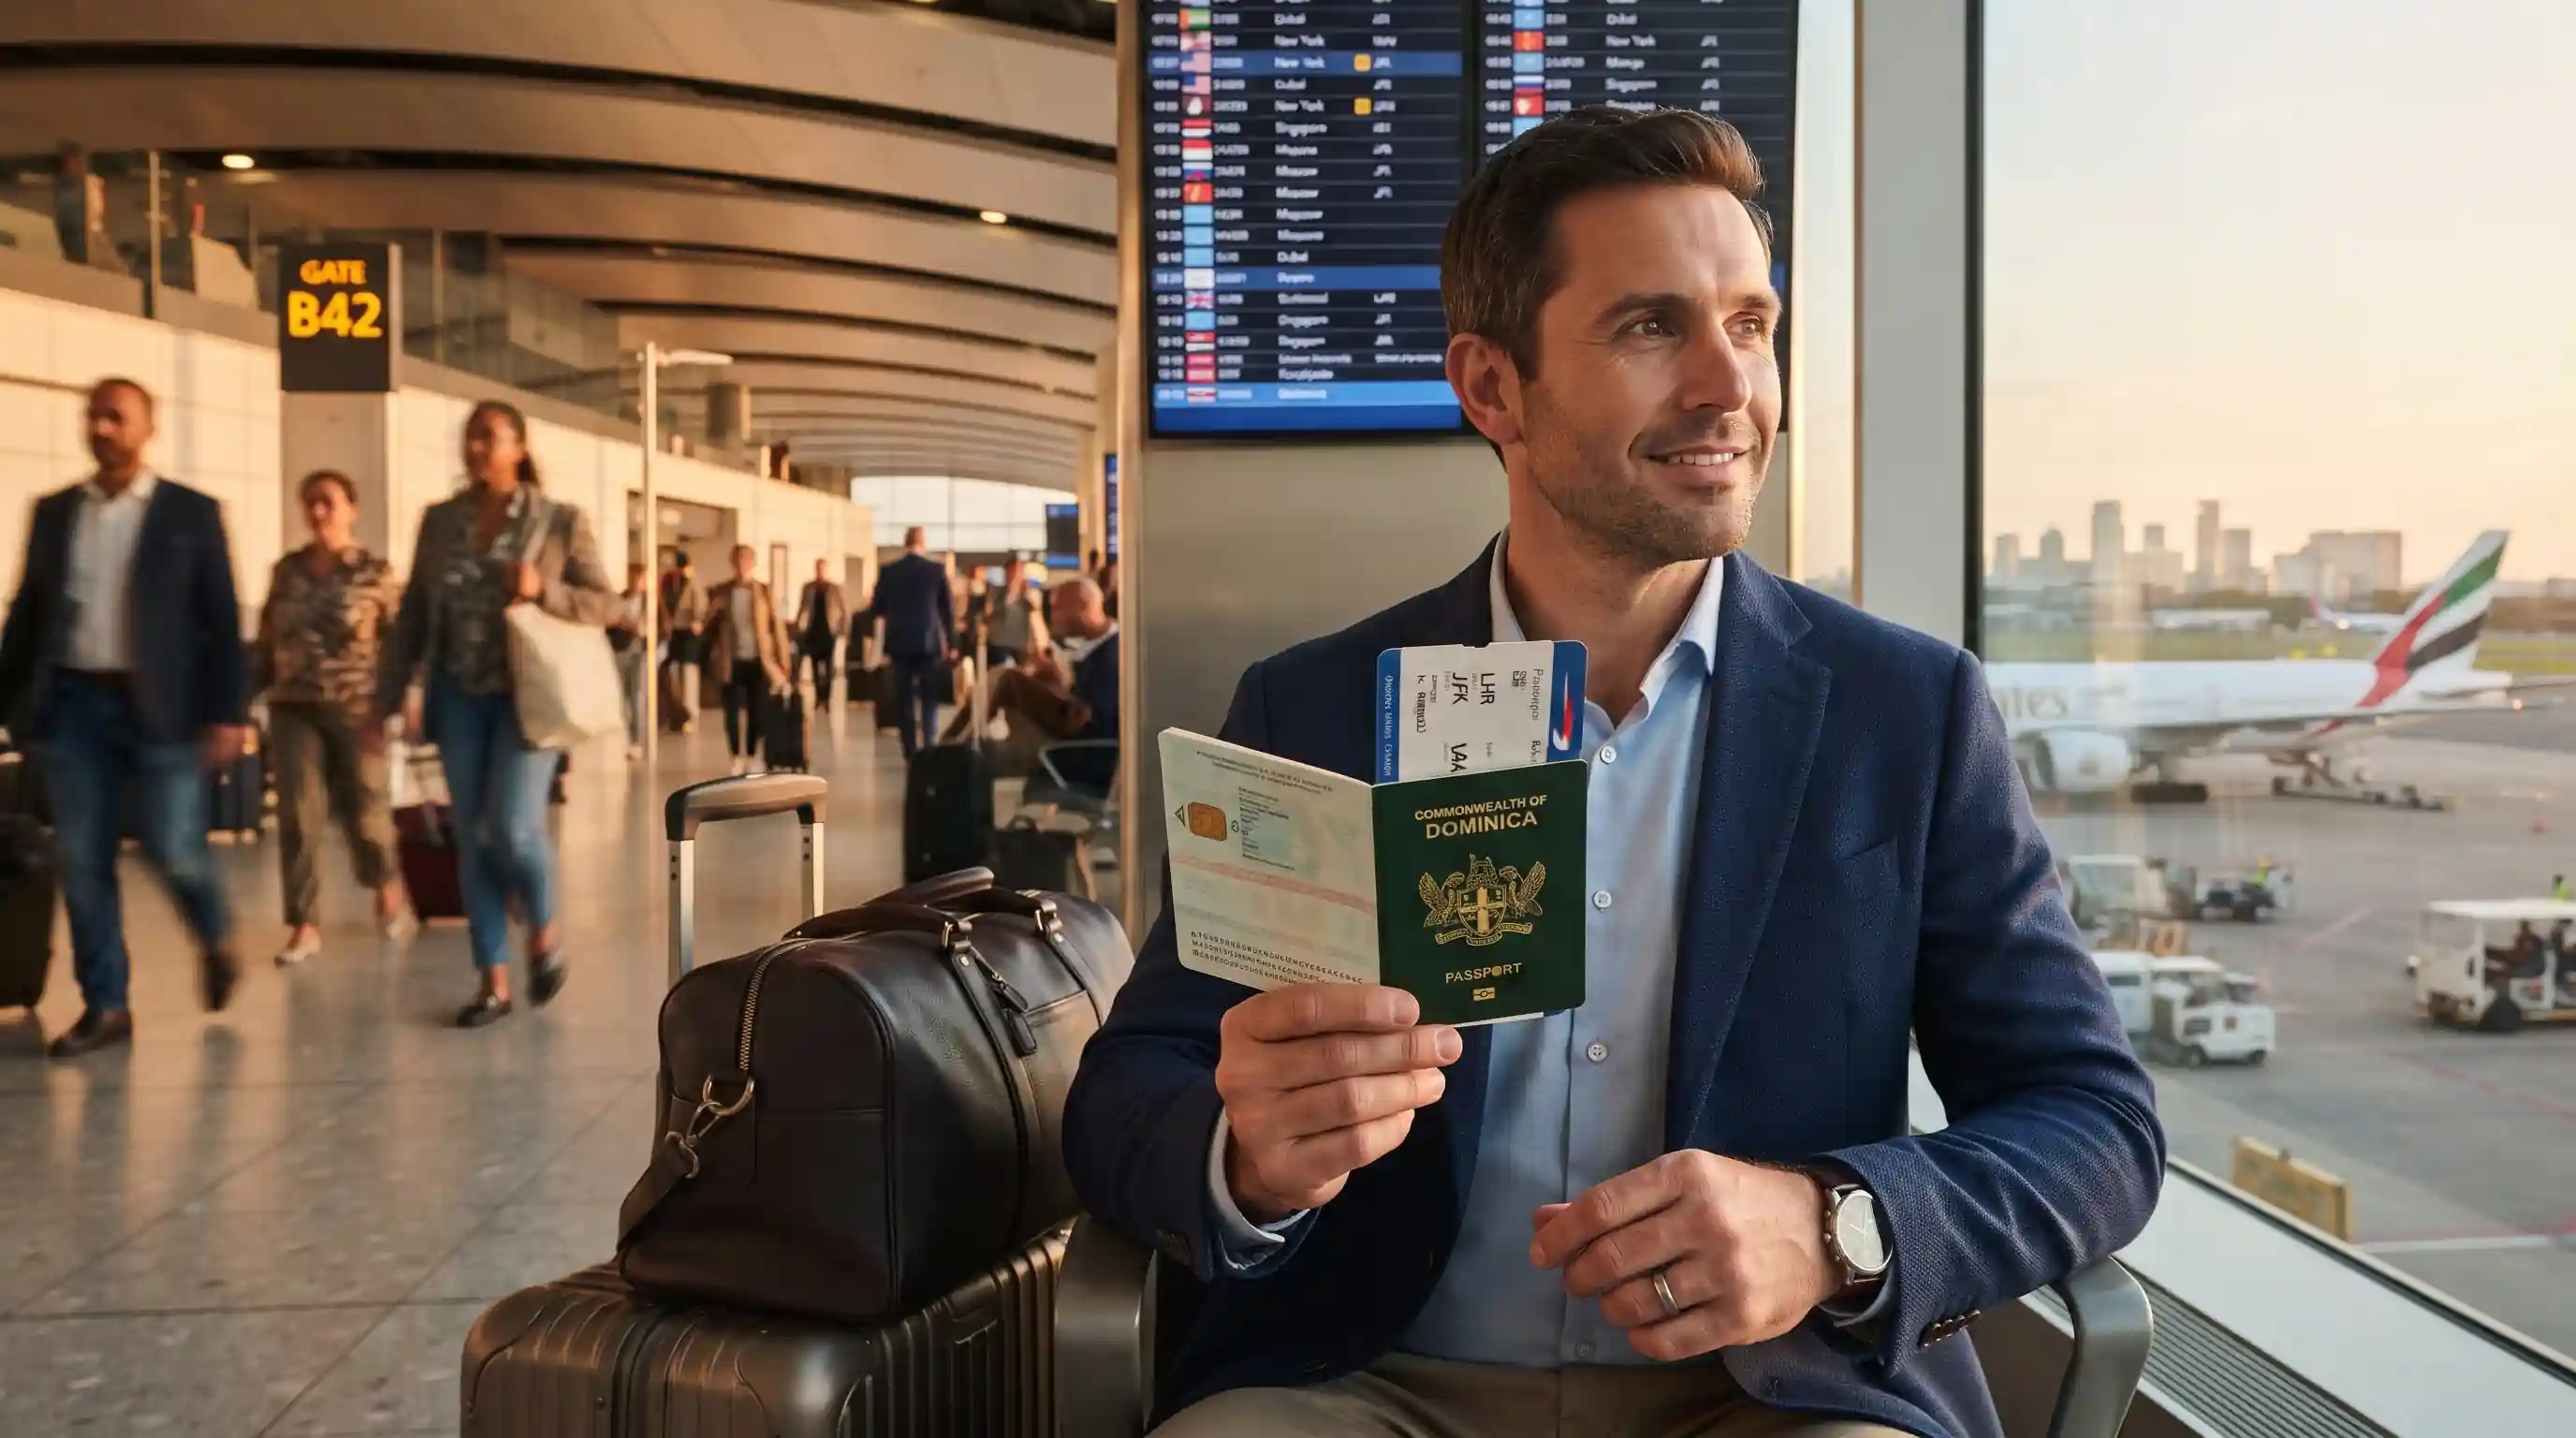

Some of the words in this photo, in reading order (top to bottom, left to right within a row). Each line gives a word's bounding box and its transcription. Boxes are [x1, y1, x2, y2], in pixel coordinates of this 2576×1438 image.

[300, 259, 368, 285] GATE
[287, 290, 383, 338] B42
[1452, 672, 1469, 705] JFK
[1480, 672, 1496, 705] LHR
[1414, 797, 1526, 821] COMMONWEALTH
[1529, 795, 1547, 806] OF
[1426, 811, 1538, 839] DOMINICA
[1445, 962, 1522, 983] PASSPORT
